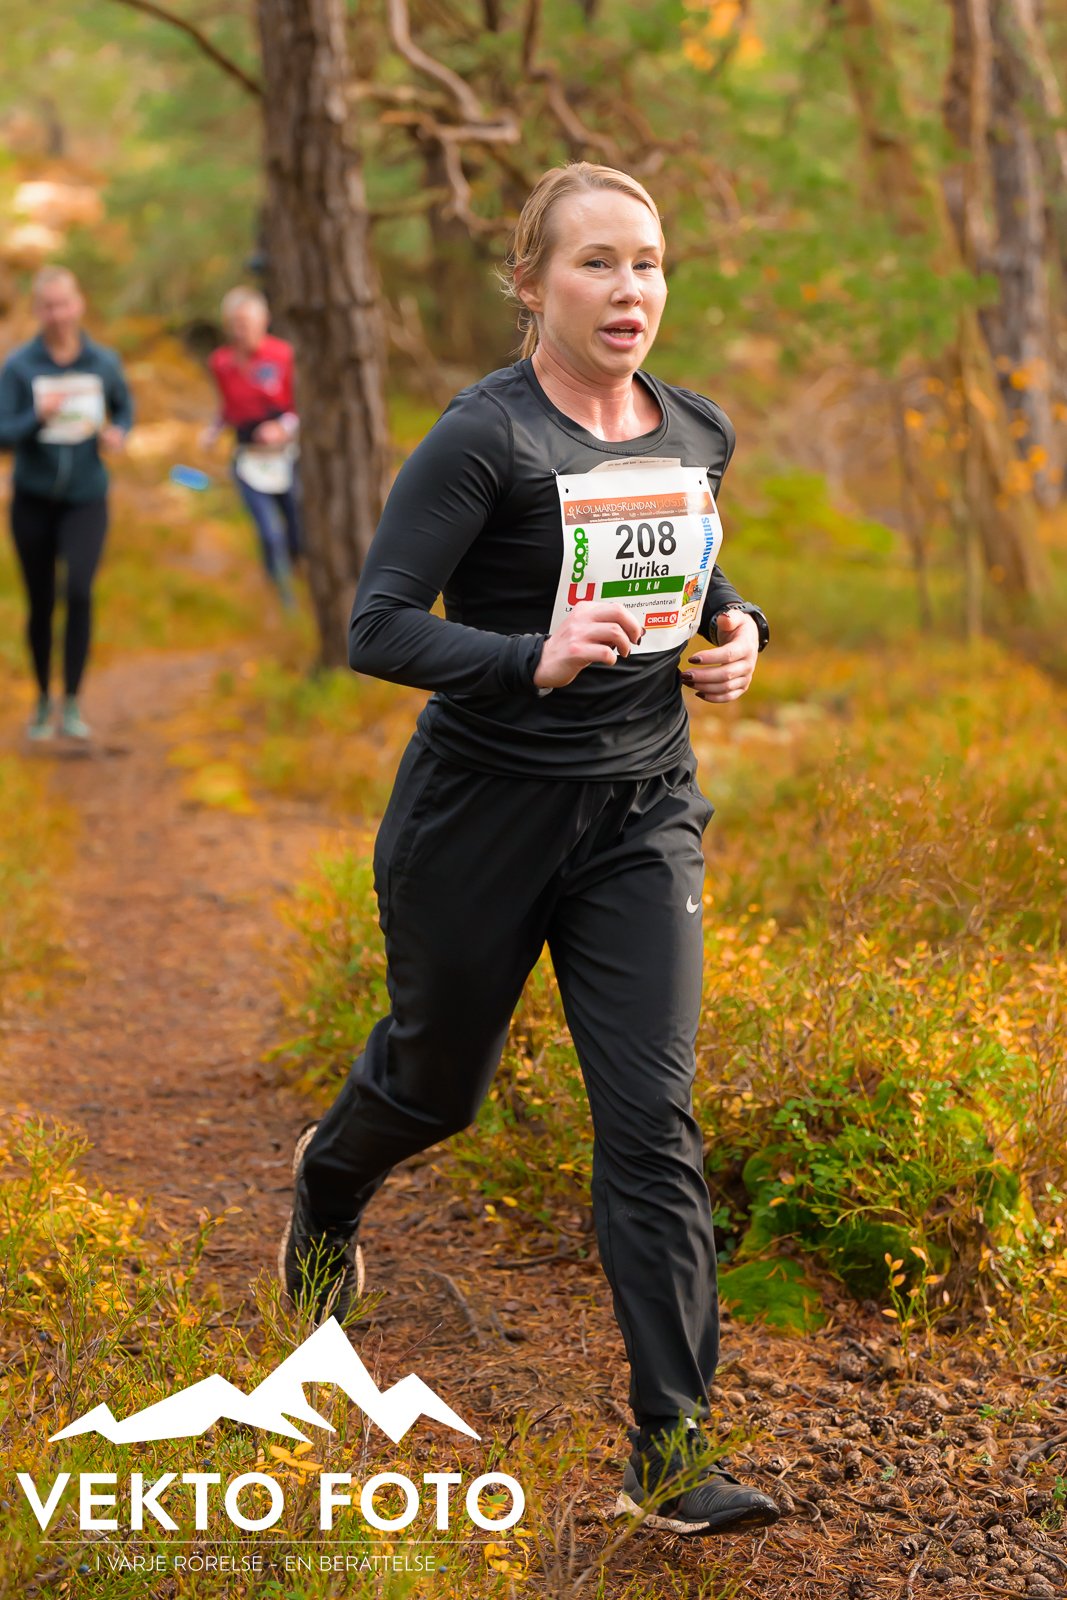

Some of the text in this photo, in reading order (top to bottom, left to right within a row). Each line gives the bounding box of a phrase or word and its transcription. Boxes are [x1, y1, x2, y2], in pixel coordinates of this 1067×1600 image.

[615, 521, 677, 559] 208
[699, 516, 714, 570] Aktivitus
[571, 527, 589, 583] coop
[621, 561, 669, 580] Ulrika
[628, 581, 660, 592] 10 KM
[647, 615, 669, 624] CIRCLE
